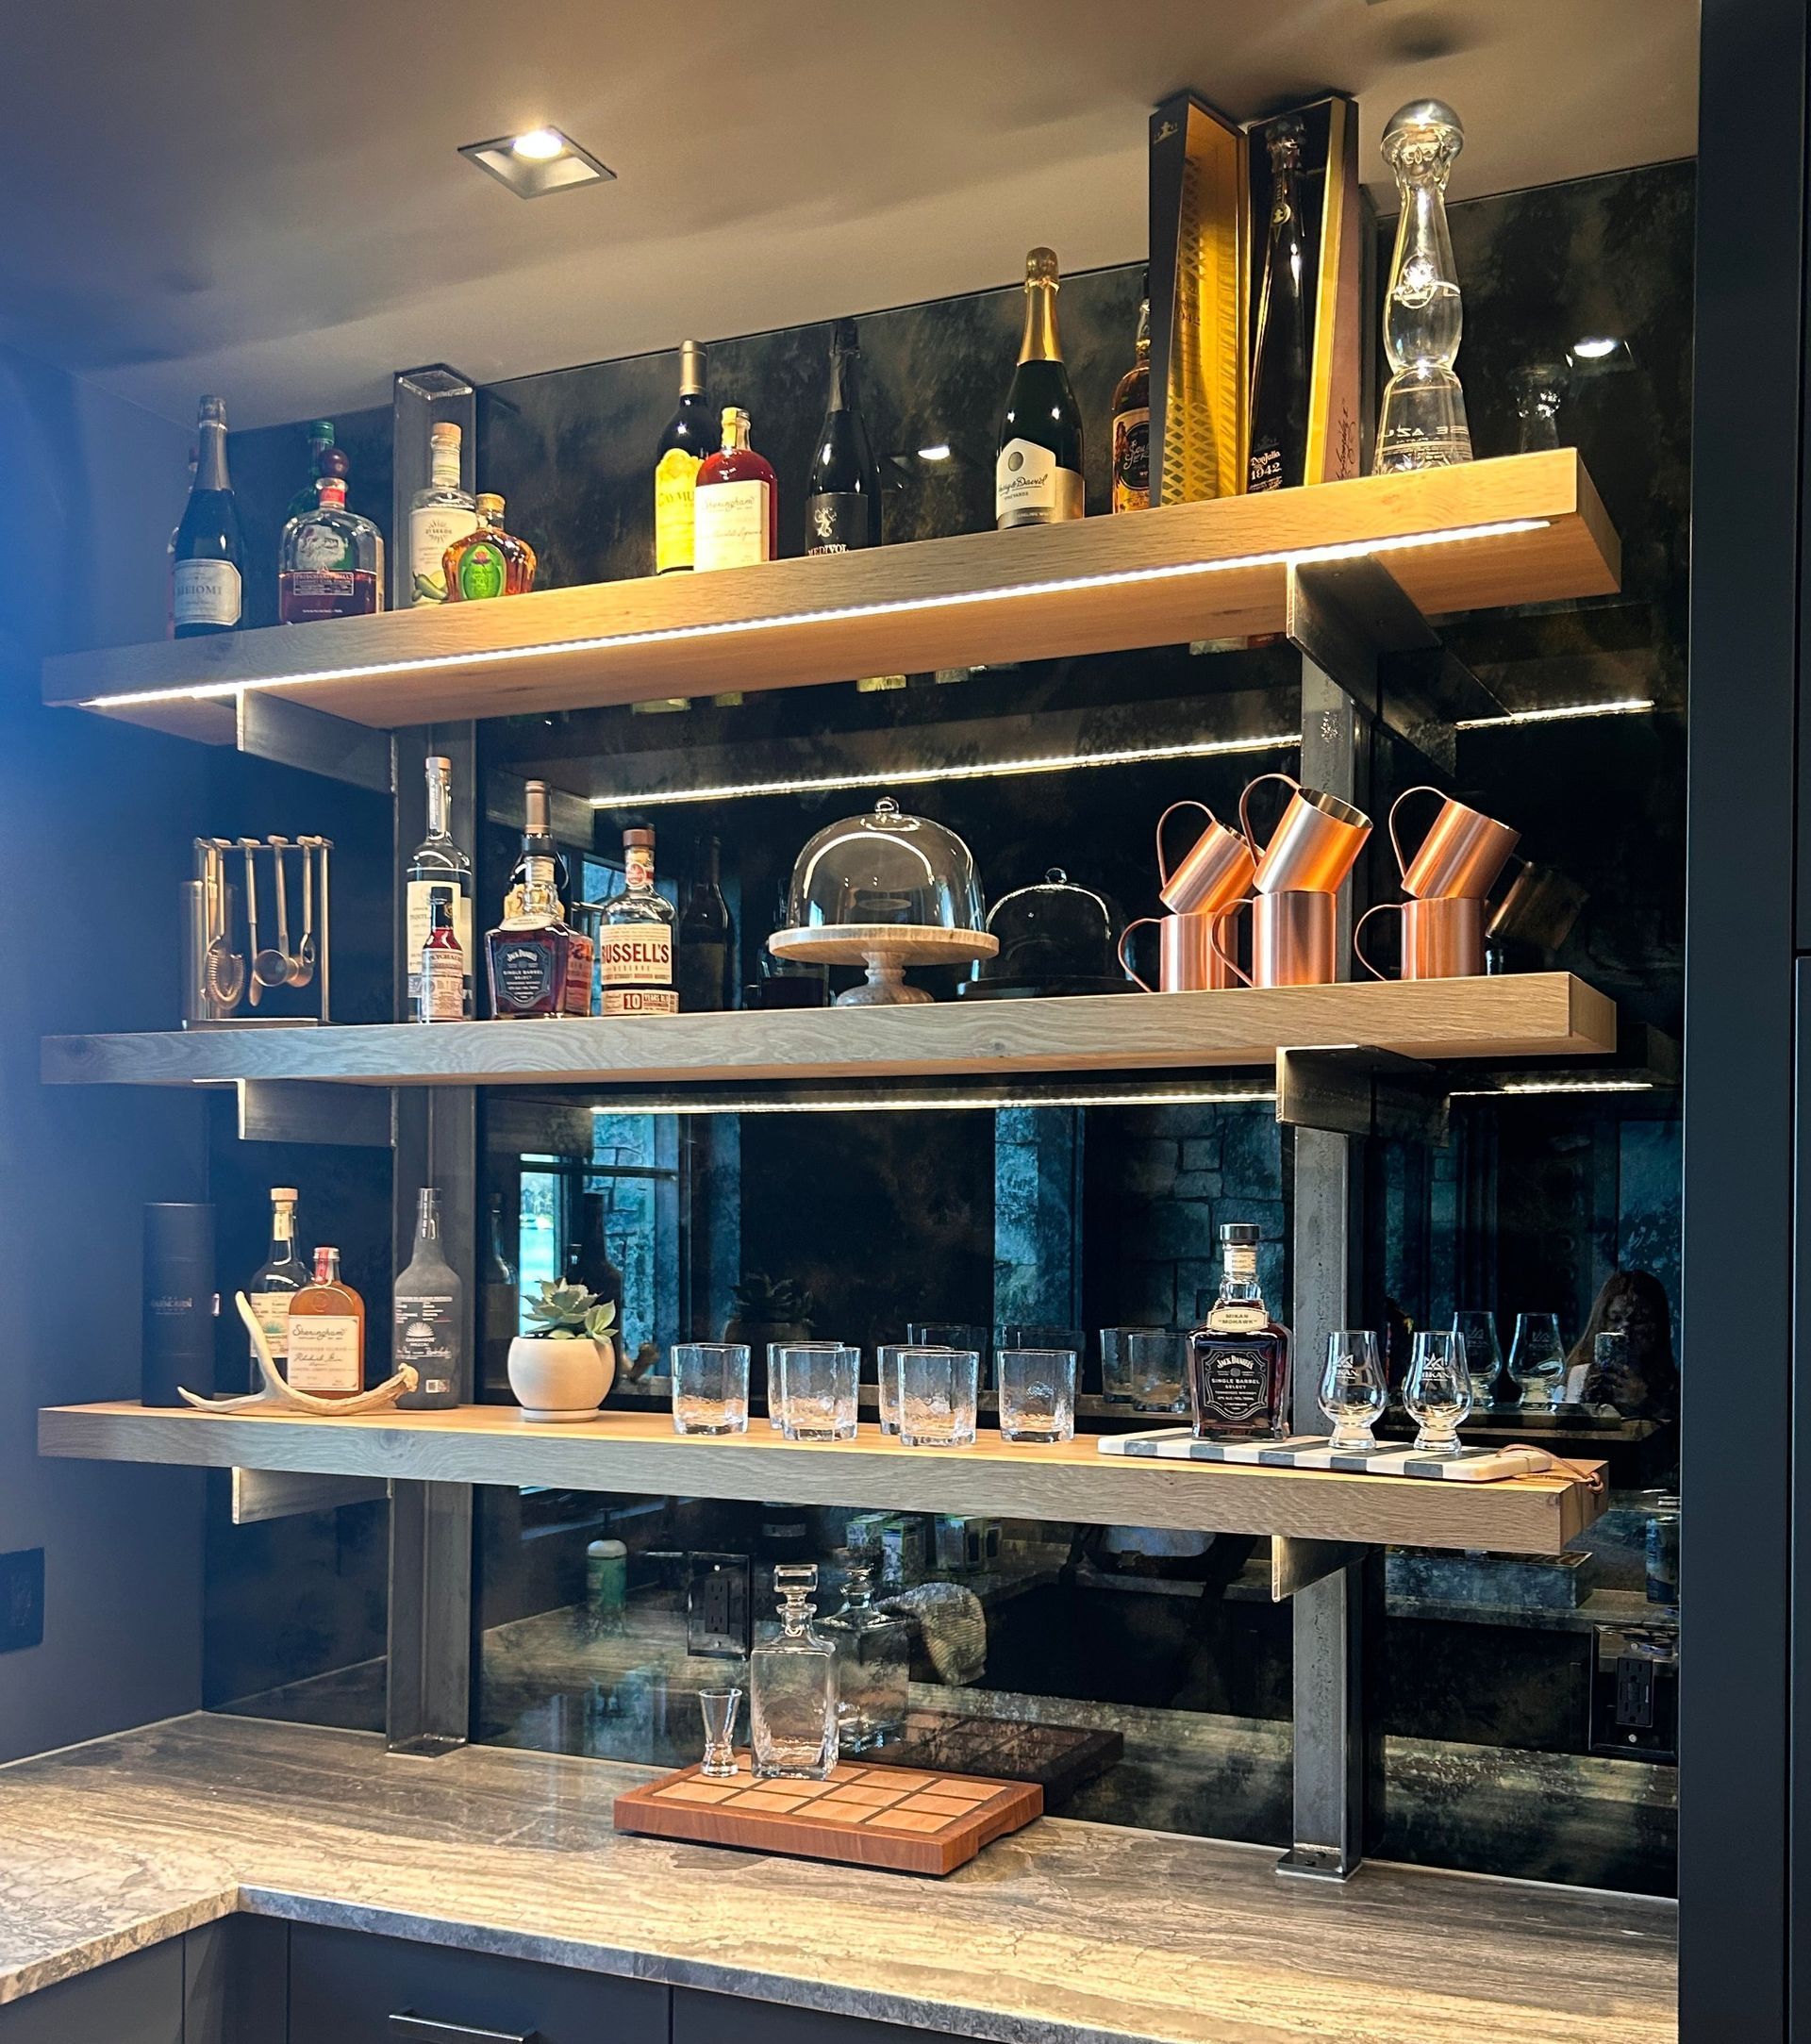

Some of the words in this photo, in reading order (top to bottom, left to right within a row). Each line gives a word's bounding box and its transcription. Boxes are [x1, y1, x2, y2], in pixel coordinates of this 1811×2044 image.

[1252, 462, 1282, 481] 1942
[600, 942, 670, 964] RUSSELL'S
[624, 993, 642, 1010] 10
[292, 1323, 348, 1340] Sheringham
[1217, 1357, 1232, 1369] JACK
